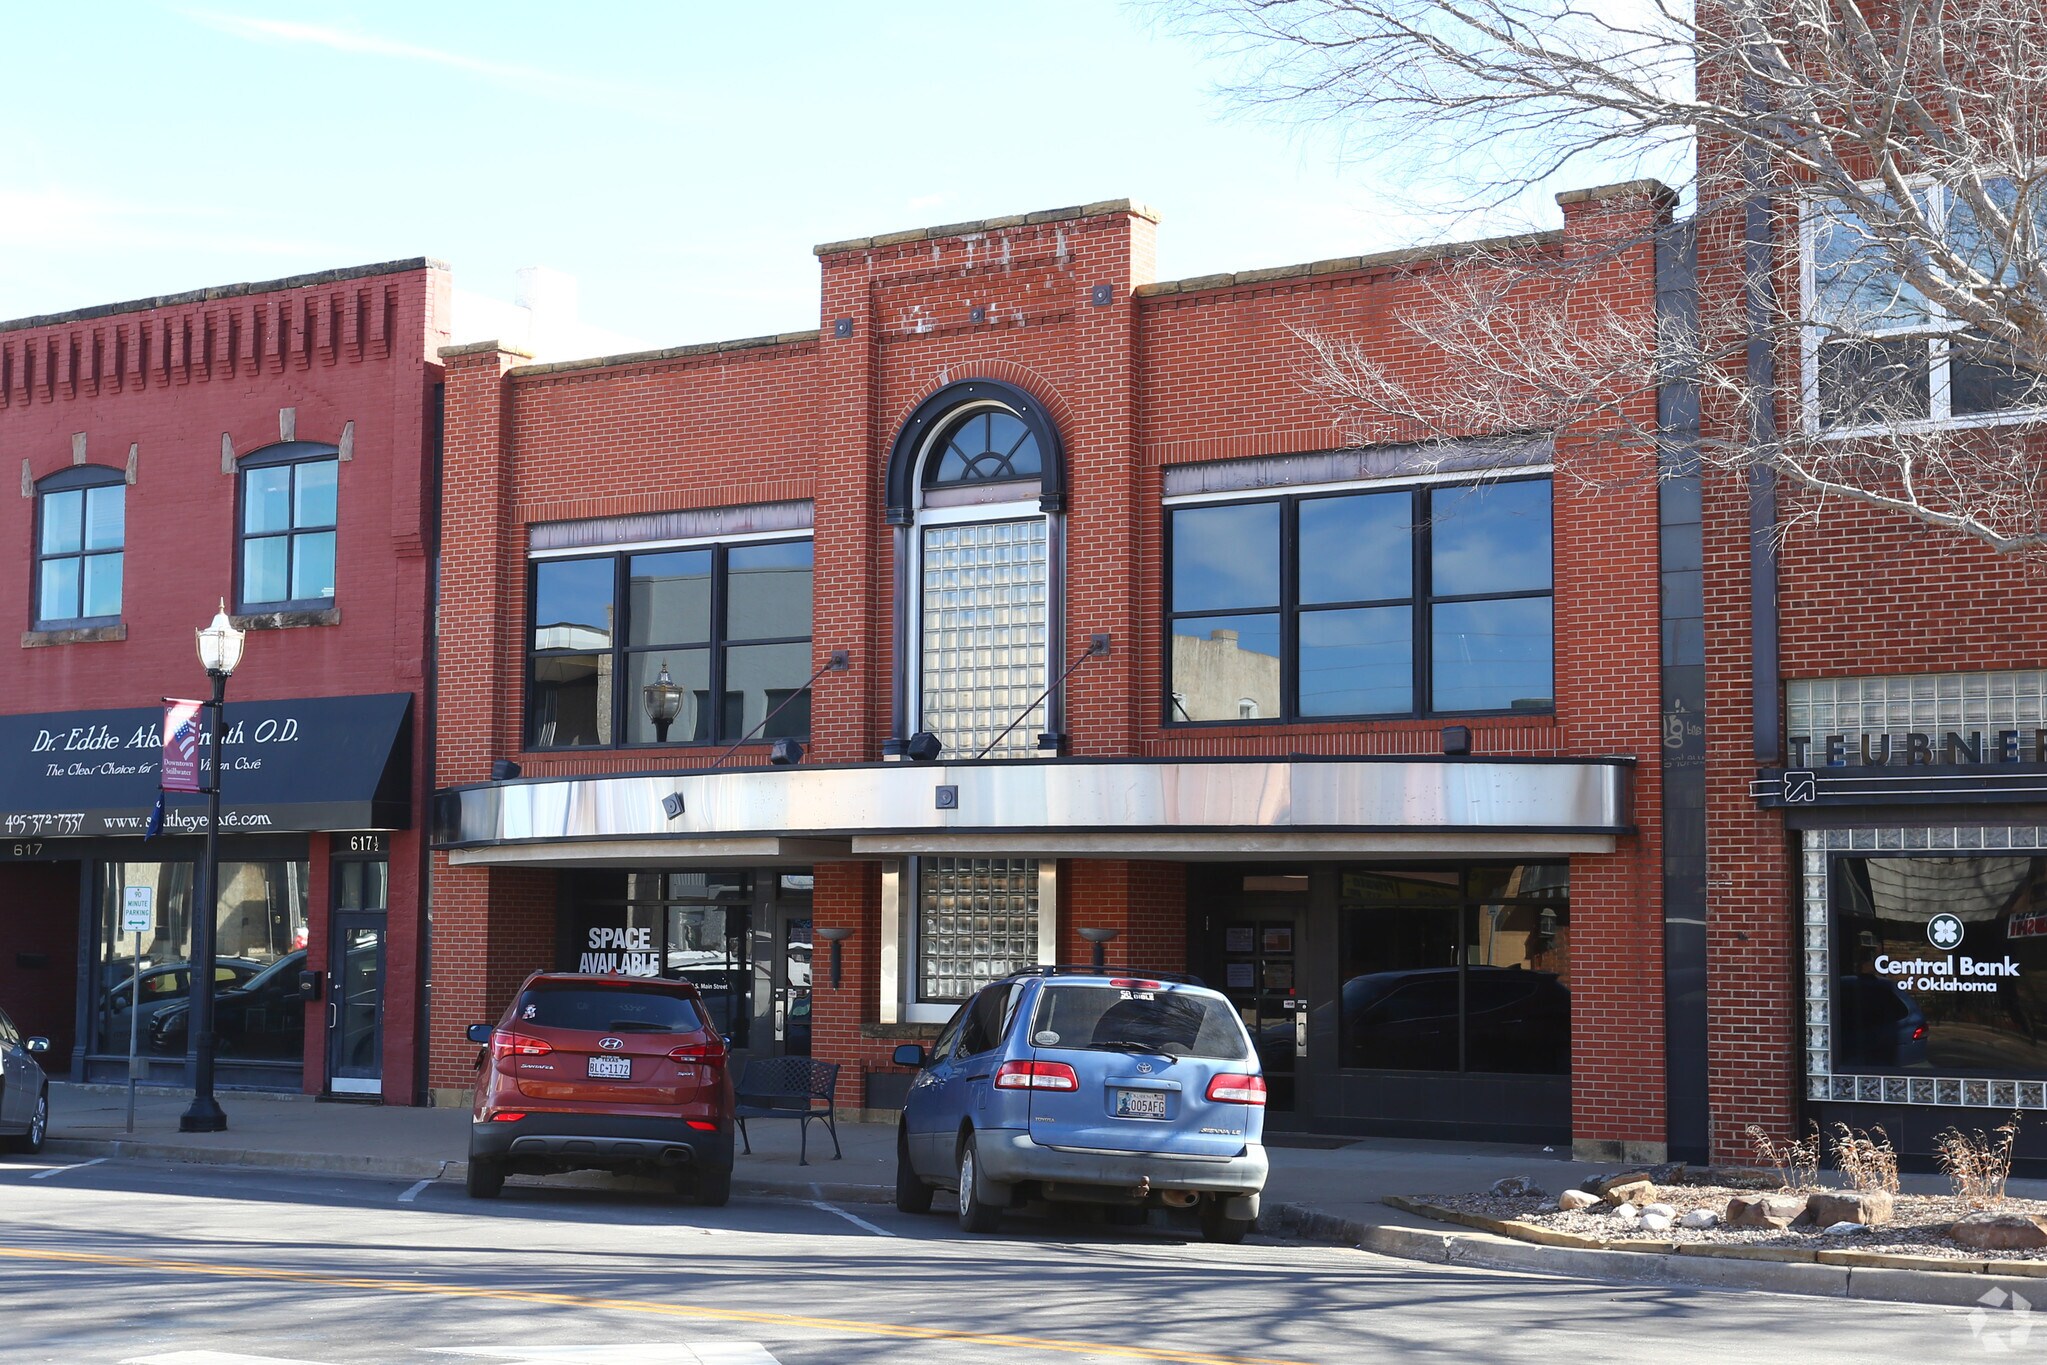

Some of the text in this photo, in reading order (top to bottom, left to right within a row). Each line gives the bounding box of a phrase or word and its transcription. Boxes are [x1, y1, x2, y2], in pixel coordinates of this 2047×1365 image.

[31, 729, 65, 752] Dr.
[64, 724, 119, 751] Eddie
[254, 718, 299, 743] O.D.
[45, 763, 64, 776] The
[67, 761, 101, 775] Clear
[100, 762, 136, 775] Choice
[138, 761, 158, 774] for
[234, 756, 262, 770] Care
[163, 758, 194, 768] Downtown
[165, 767, 192, 777] Stillwater
[13, 843, 43, 856] 617
[588, 927, 651, 949] SPACE
[578, 952, 660, 974] AVAILABLE
[1874, 954, 2021, 977] Central Bank
[1897, 976, 1997, 993] of Oklahoma
[1130, 1099, 1165, 1113] 005AFG
[1200, 1126, 1231, 1135] SIENNA
